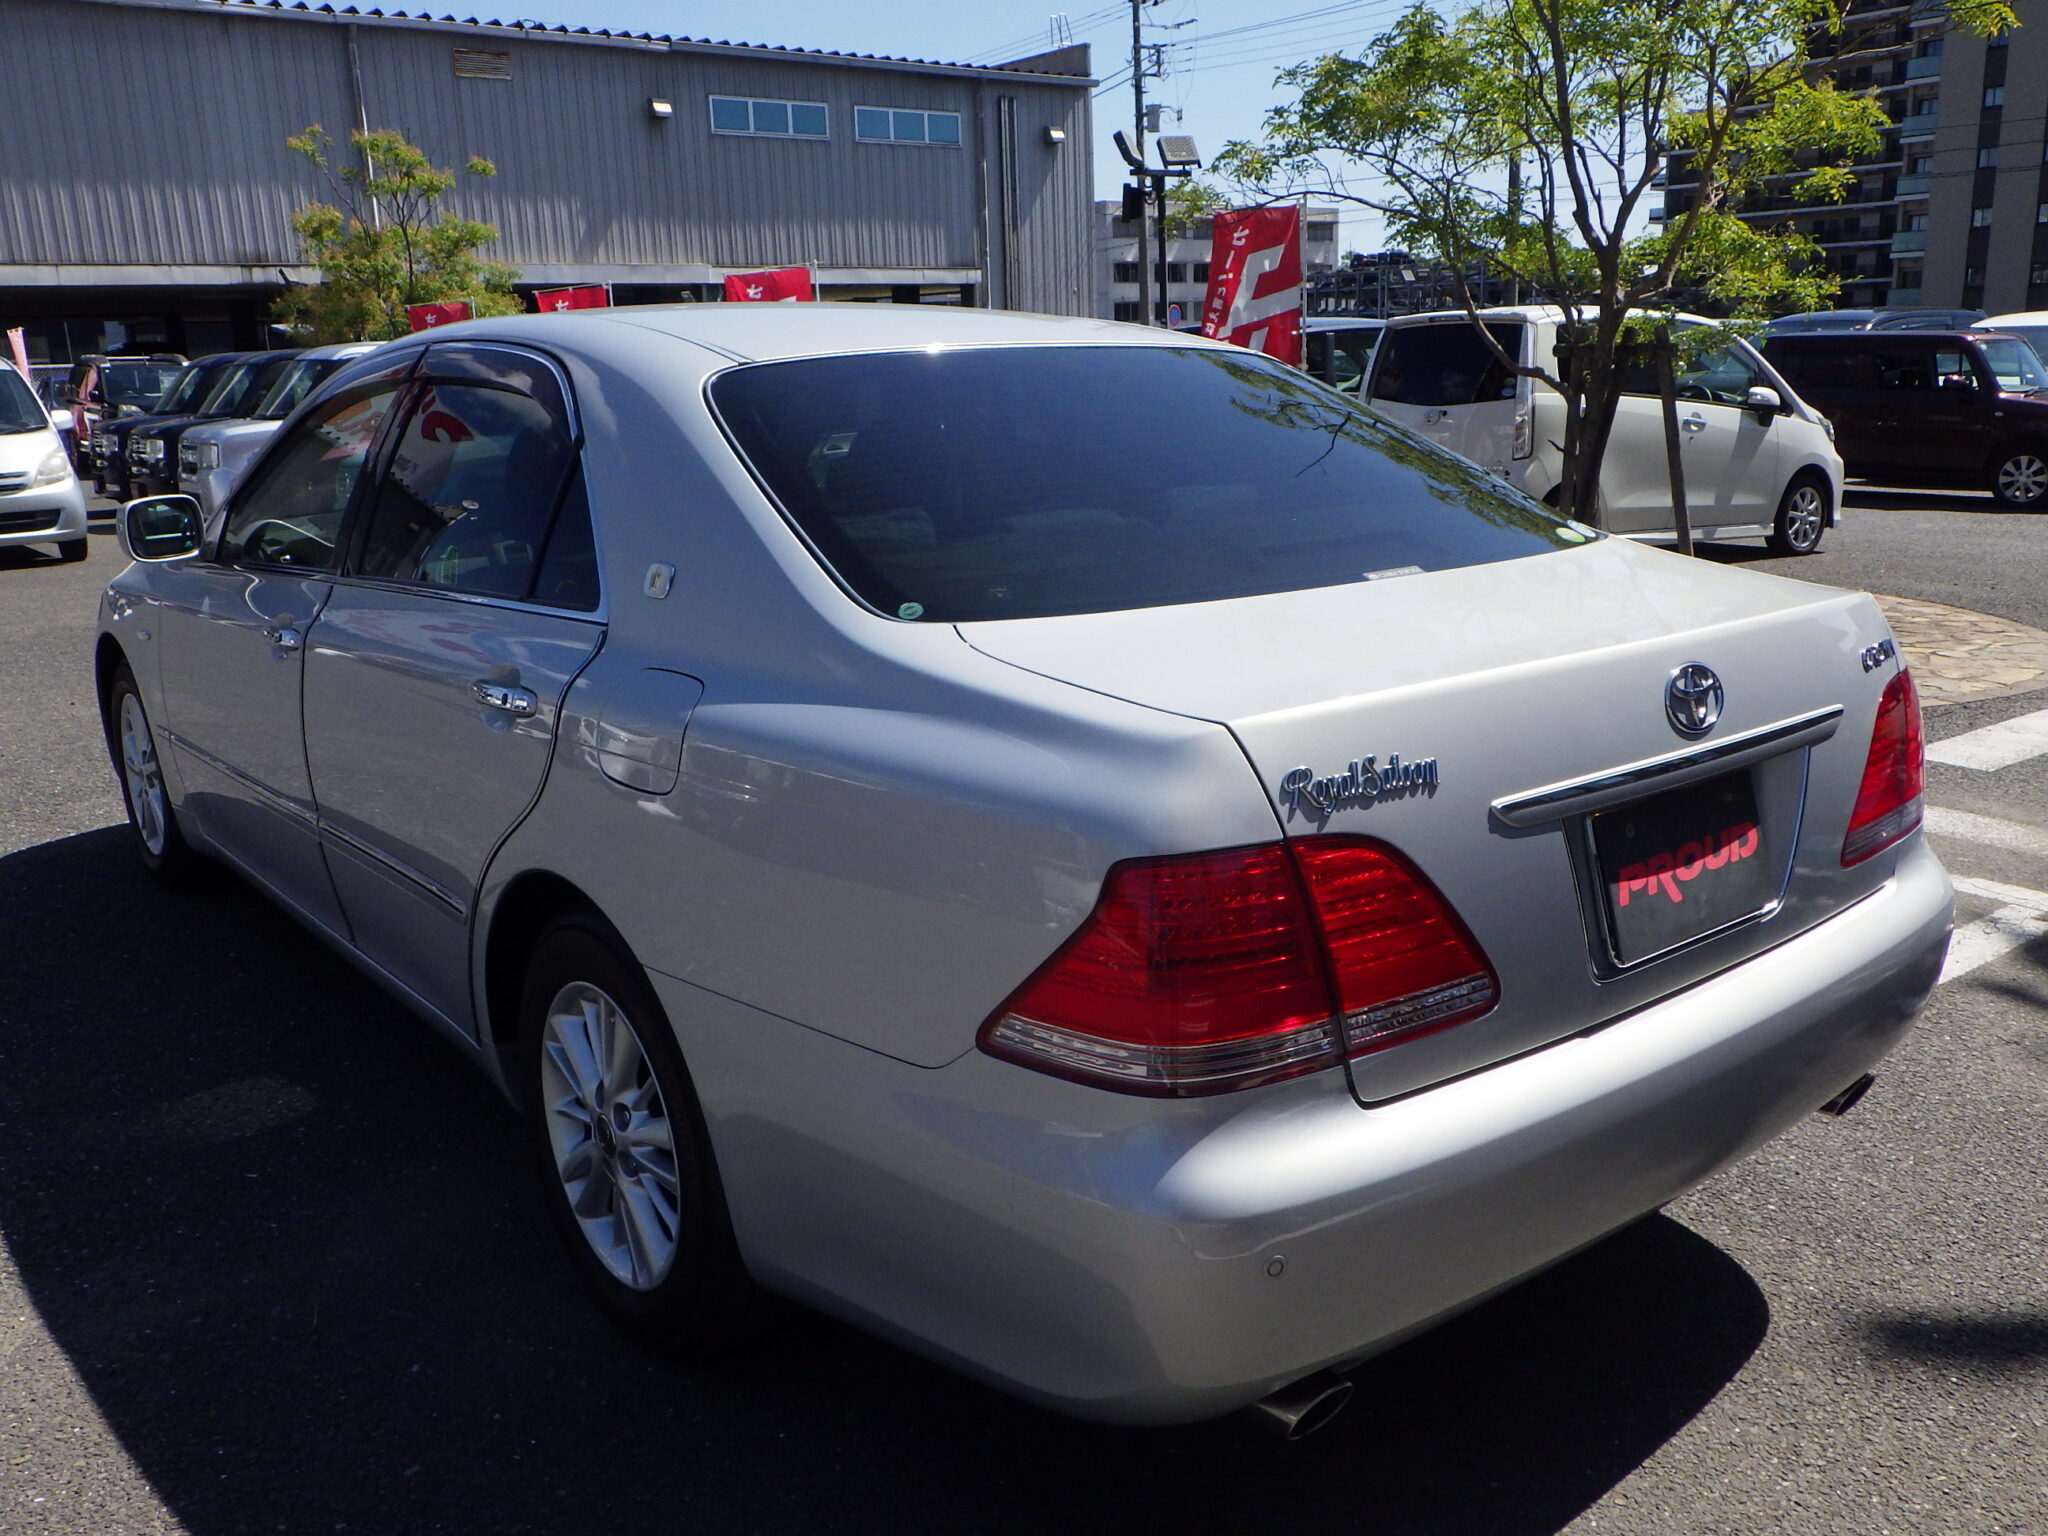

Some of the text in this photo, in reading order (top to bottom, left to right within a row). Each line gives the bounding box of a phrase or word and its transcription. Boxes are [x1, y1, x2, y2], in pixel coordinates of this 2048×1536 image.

[1281, 752, 1440, 815] Royal Saloon
[1619, 822, 1758, 907] PROUD
